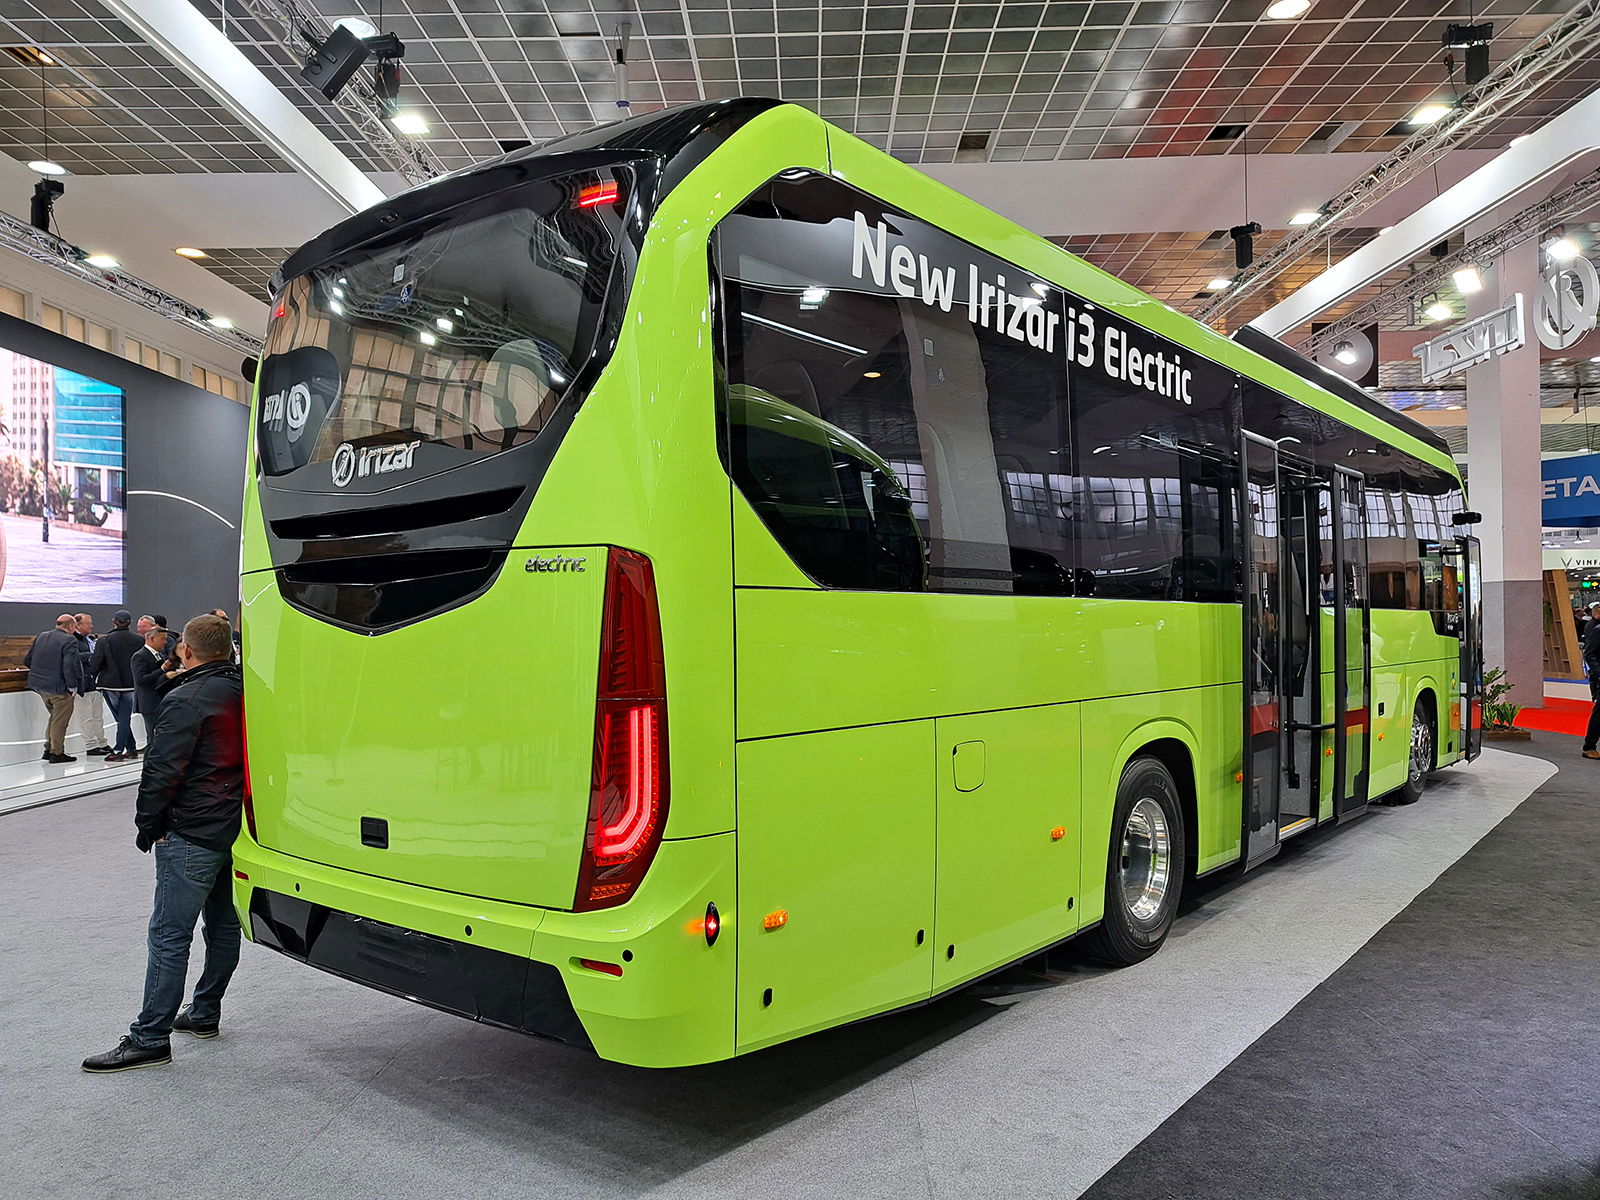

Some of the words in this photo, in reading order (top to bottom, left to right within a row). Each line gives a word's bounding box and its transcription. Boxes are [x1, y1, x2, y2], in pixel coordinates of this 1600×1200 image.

[852, 210, 956, 313] New
[968, 263, 1060, 353] Irizar
[1067, 307, 1096, 368] i3
[1104, 326, 1193, 405] Electric
[525, 553, 586, 573] electric
